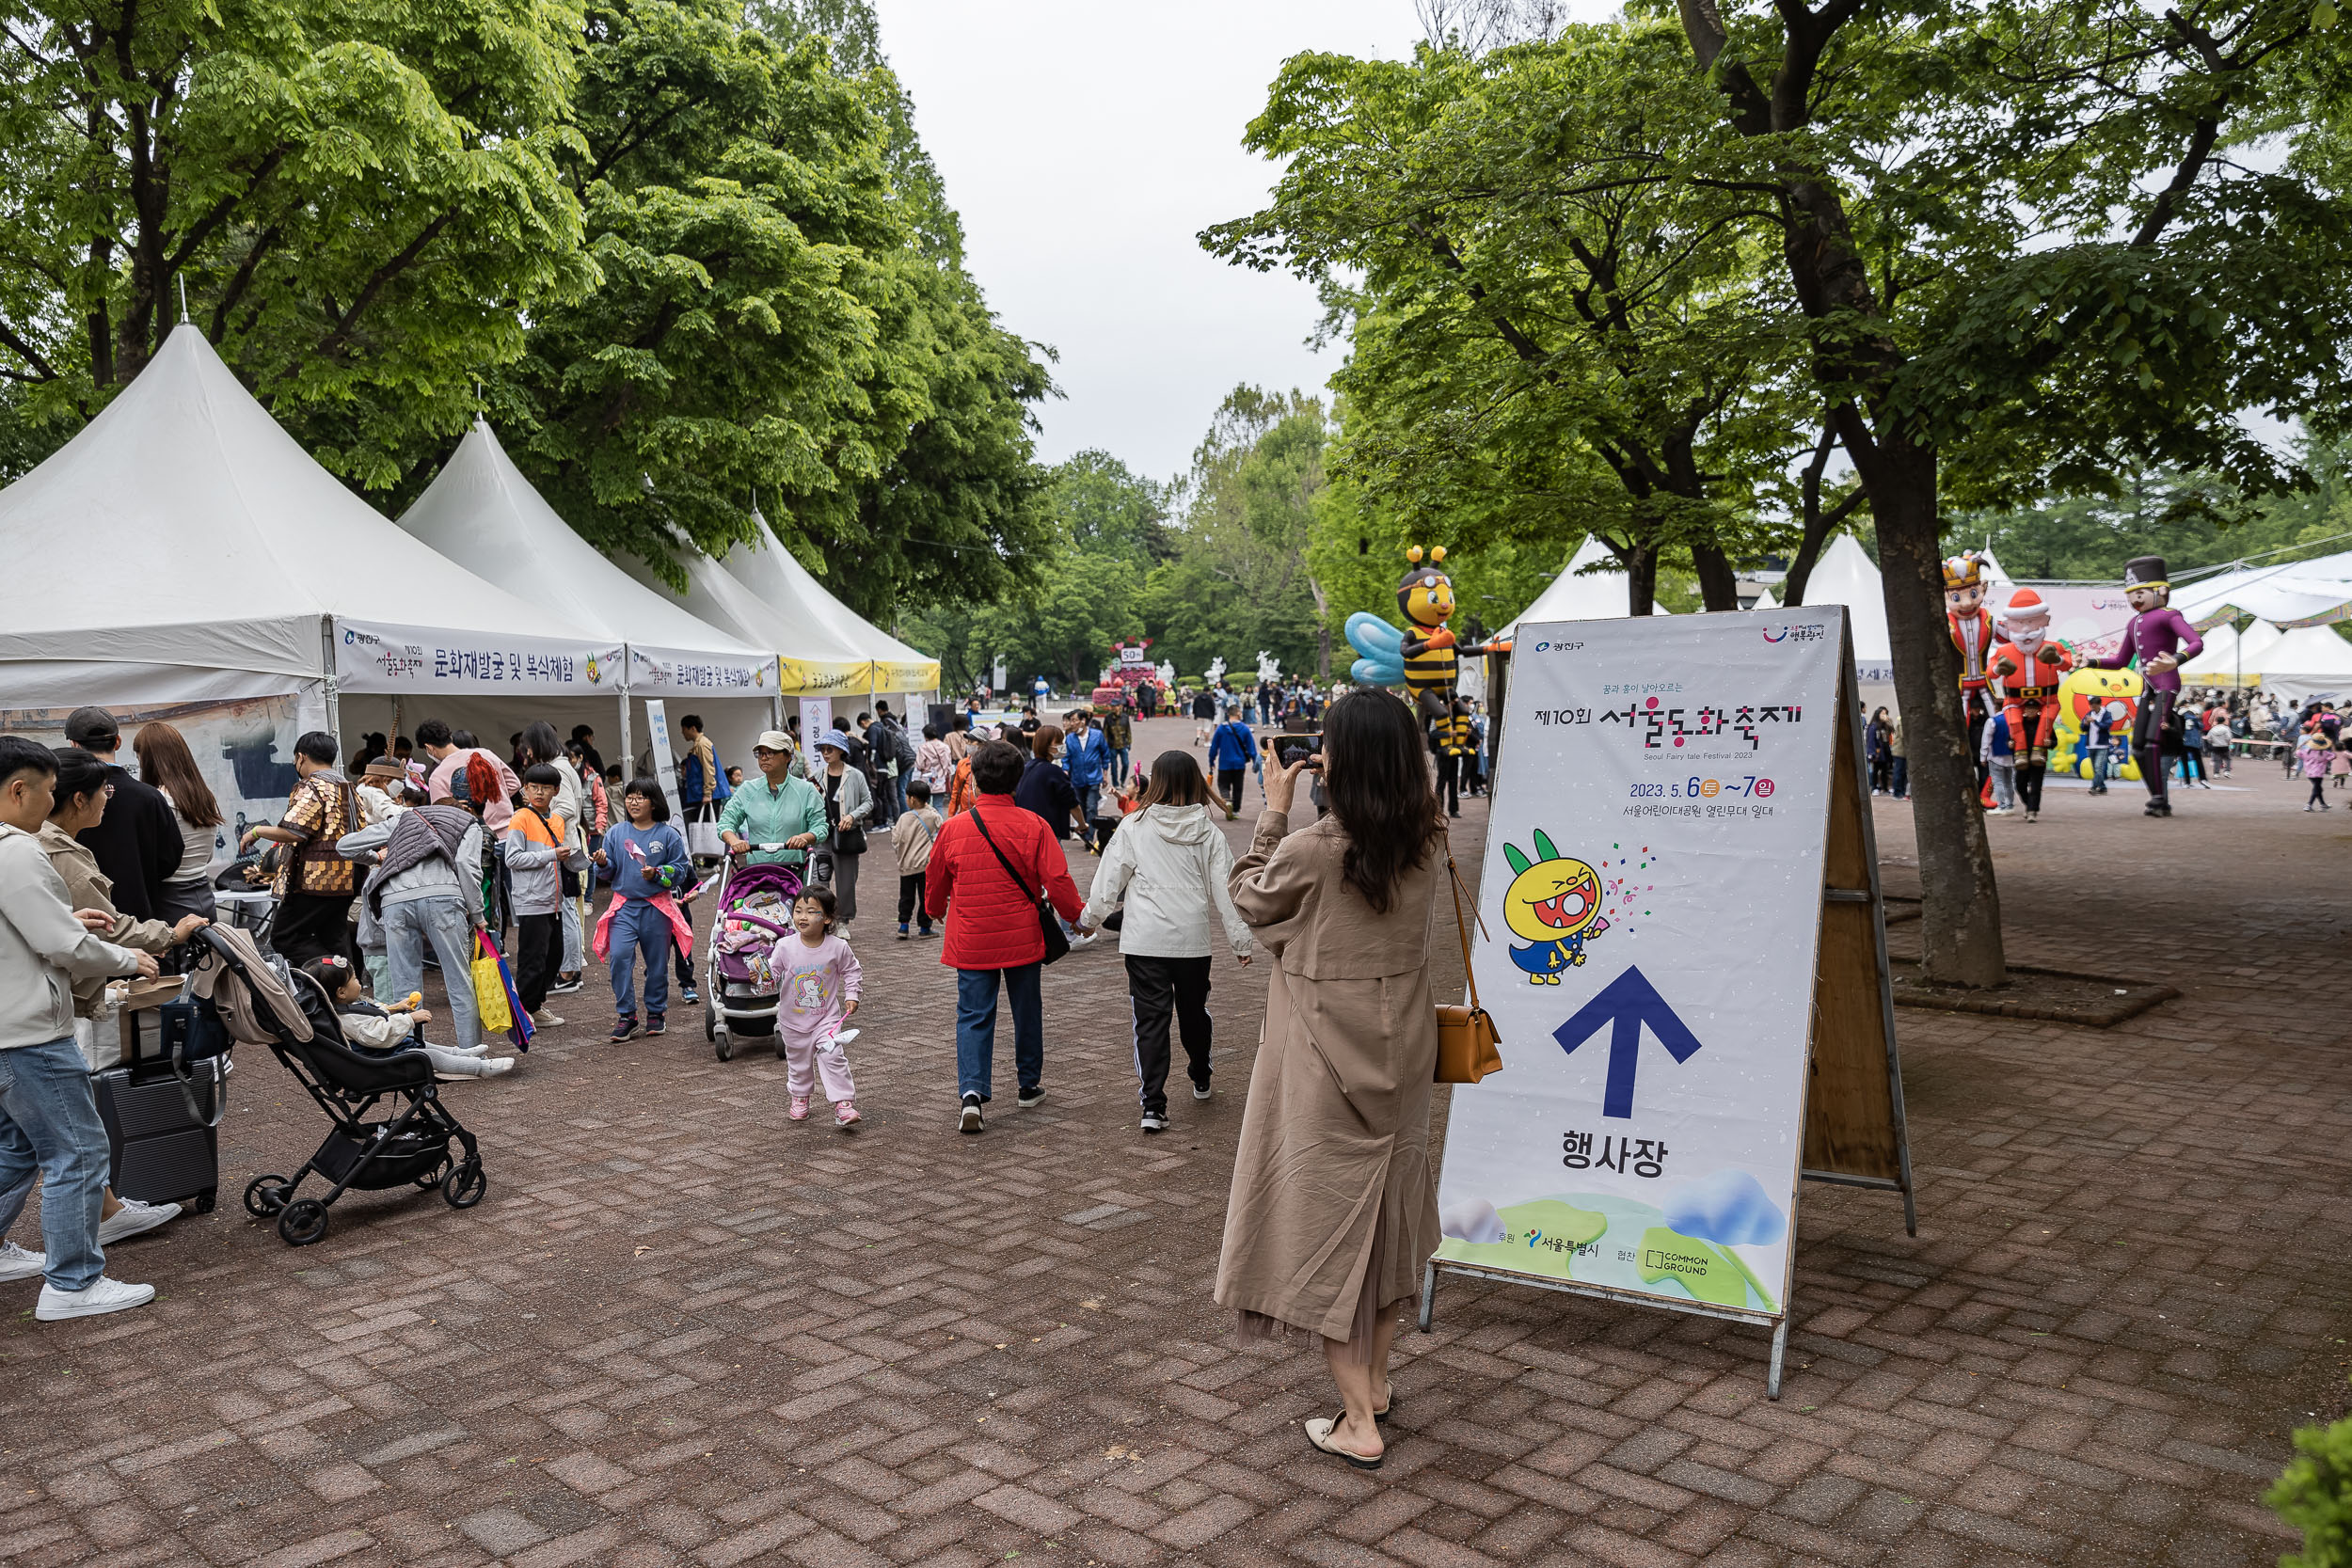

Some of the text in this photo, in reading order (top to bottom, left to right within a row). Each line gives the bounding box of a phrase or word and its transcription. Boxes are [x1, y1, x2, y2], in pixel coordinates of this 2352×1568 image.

[357, 633, 380, 645] 광진구
[1789, 630, 1824, 642] 행복광진
[1552, 641, 1584, 652] 광진구
[376, 651, 422, 679] 서울동화축제
[435, 649, 573, 682] 문화재발굴 및 복식체험
[676, 664, 751, 688] 문화재발굴 및 복식체험
[1603, 684, 1620, 694] 꿈과
[1642, 683, 1682, 694] 날아오르는
[1534, 697, 1802, 751] 제10회 서울동화축제
[1666, 752, 1684, 761] Fairy
[1703, 752, 1731, 760] Festival
[1629, 784, 1666, 798] 2023.
[1623, 804, 1773, 818] 서울어린이대공원 열린무대 일대
[1562, 1130, 1668, 1178] 행사장
[1498, 1232, 1599, 1258] 후원 서울특별시
[1617, 1250, 1636, 1262] 협찬
[1664, 1252, 1708, 1266] COMMON
[1663, 1262, 1708, 1275] GROUND
